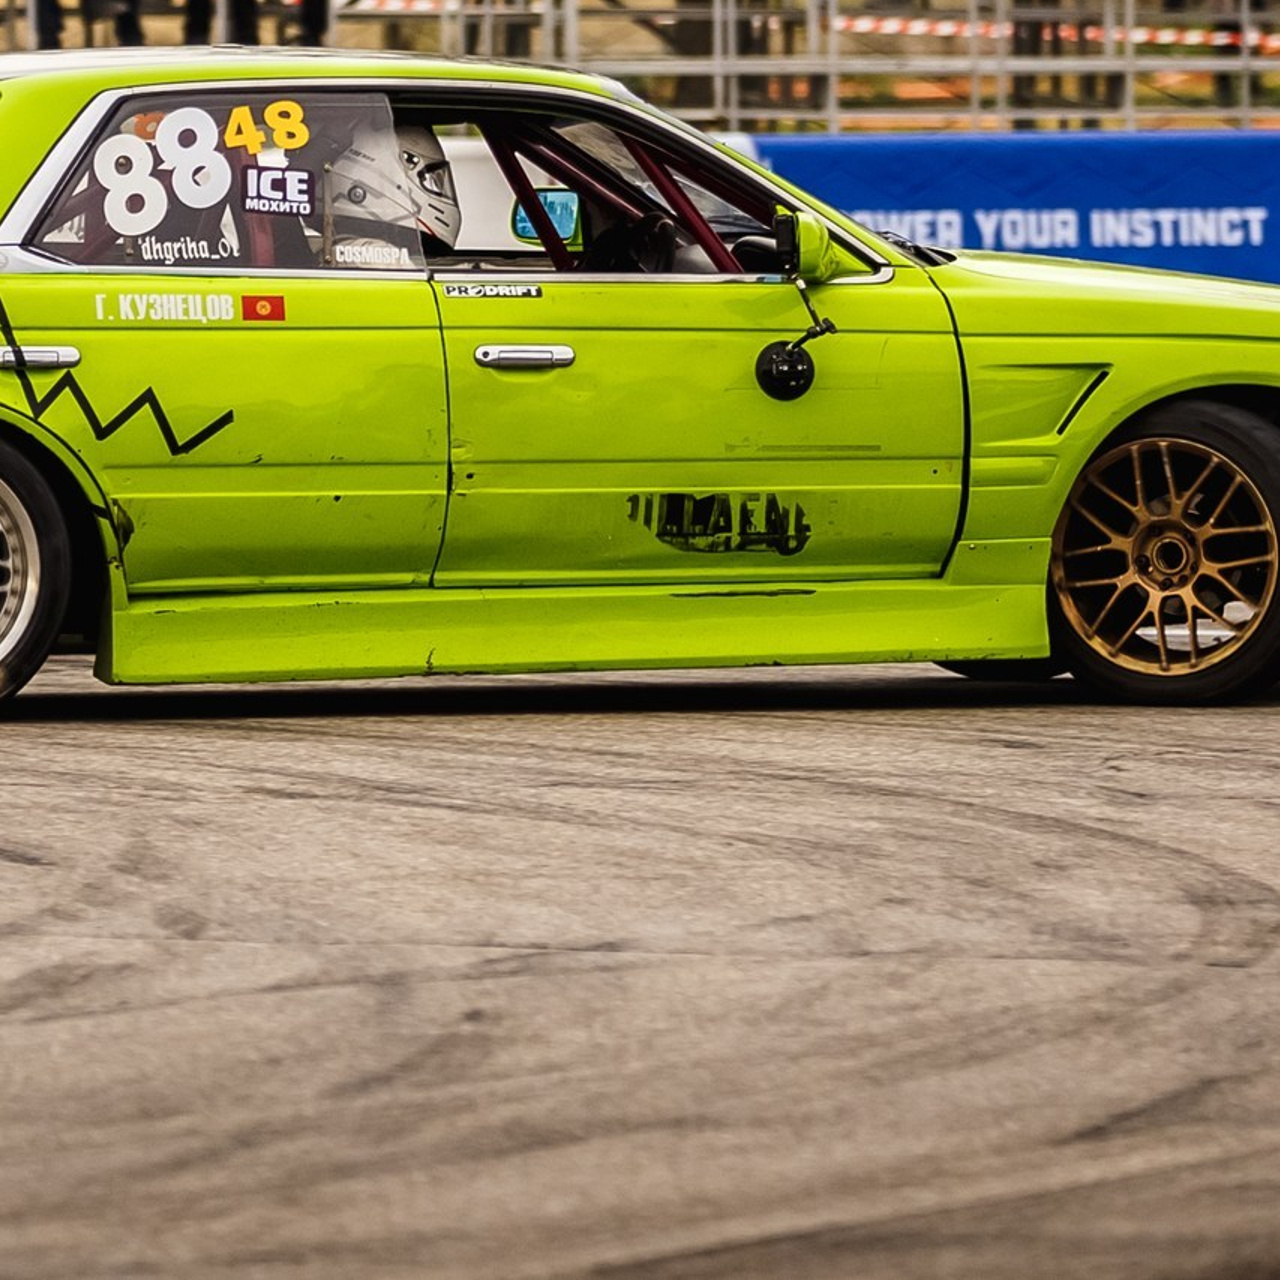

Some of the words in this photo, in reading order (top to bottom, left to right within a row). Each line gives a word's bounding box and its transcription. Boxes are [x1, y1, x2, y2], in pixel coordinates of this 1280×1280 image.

[223, 100, 310, 155] 48
[93, 107, 232, 236] 88
[247, 169, 309, 201] ICE
[245, 197, 311, 215] МОХИТО
[973, 209, 1078, 249] YOUR
[1090, 207, 1268, 247] INSTINCT
[95, 294, 114, 321] Г.
[118, 294, 234, 324] КУЗНЕЦОВ
